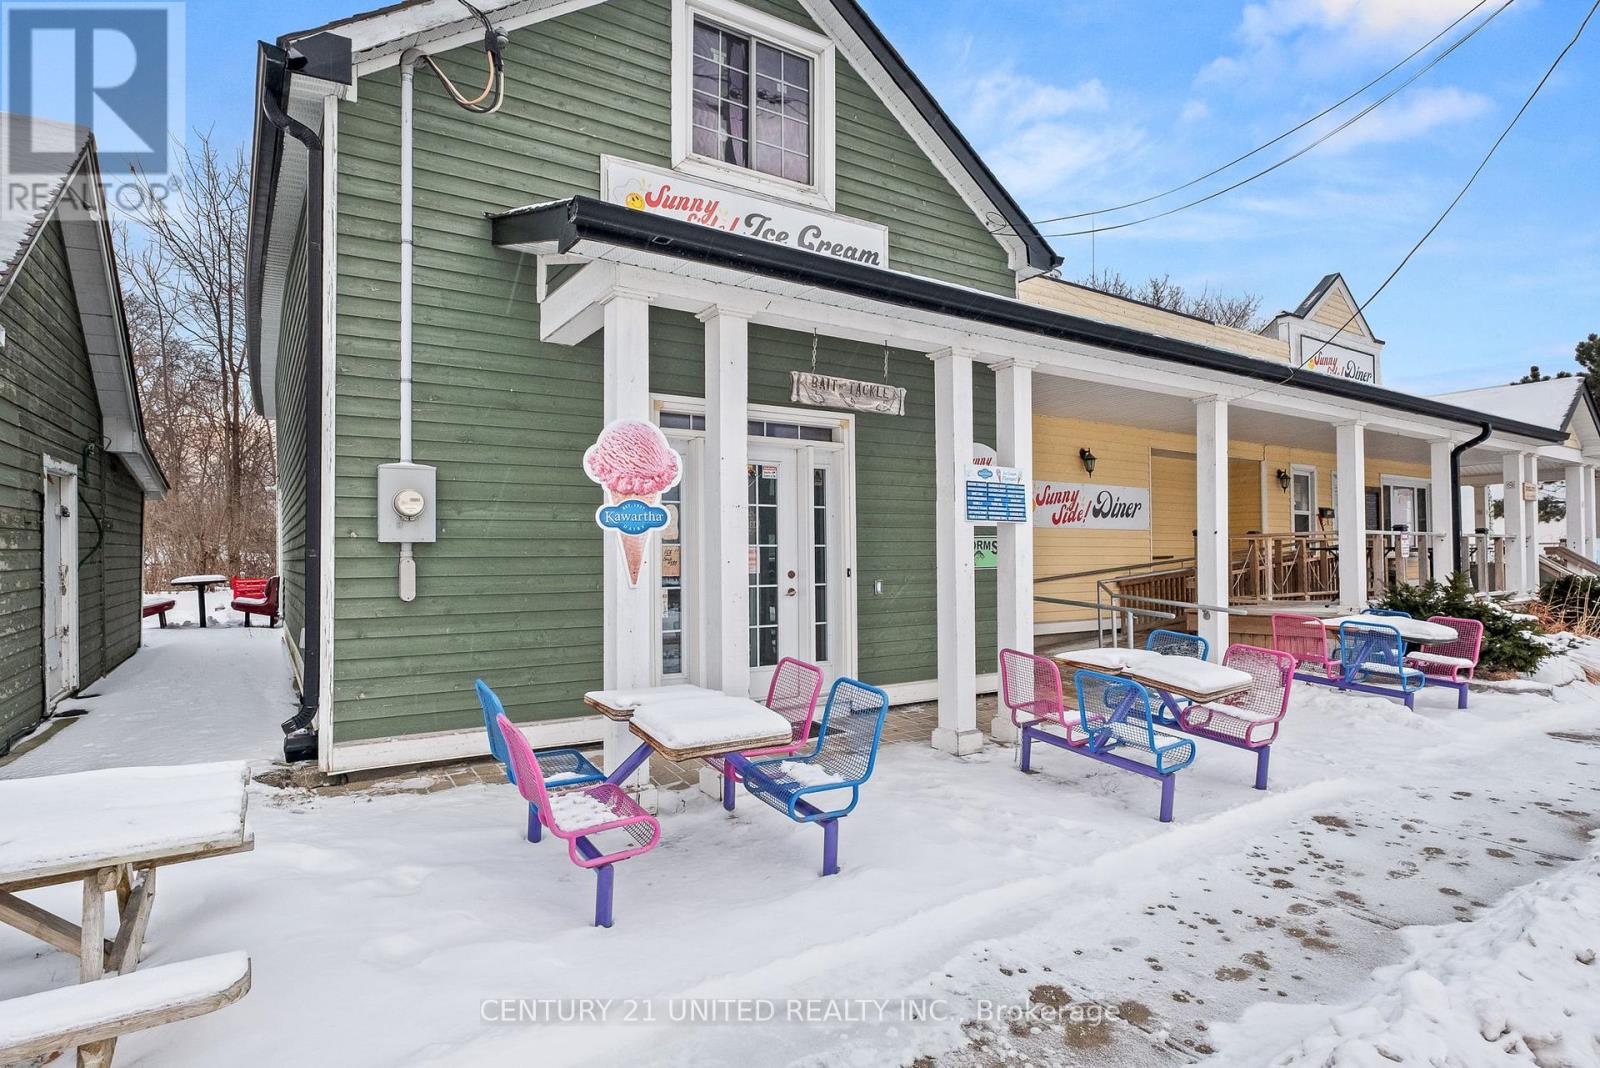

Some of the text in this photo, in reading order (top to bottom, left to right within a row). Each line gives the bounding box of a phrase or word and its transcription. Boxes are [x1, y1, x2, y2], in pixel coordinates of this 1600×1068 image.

[645, 184, 720, 223] Sunny
[744, 213, 790, 243] Ice
[797, 225, 881, 266] Cream
[1314, 351, 1337, 371] Sunny
[1344, 360, 1372, 382] Diner
[811, 376, 838, 391] BAIT
[849, 381, 890, 399] TACKLE
[1036, 485, 1080, 510] Sunny
[1093, 490, 1142, 519] Diner
[605, 511, 663, 524] Kawartha
[1051, 500, 1092, 525] Side!
[974, 540, 997, 554] RMS
